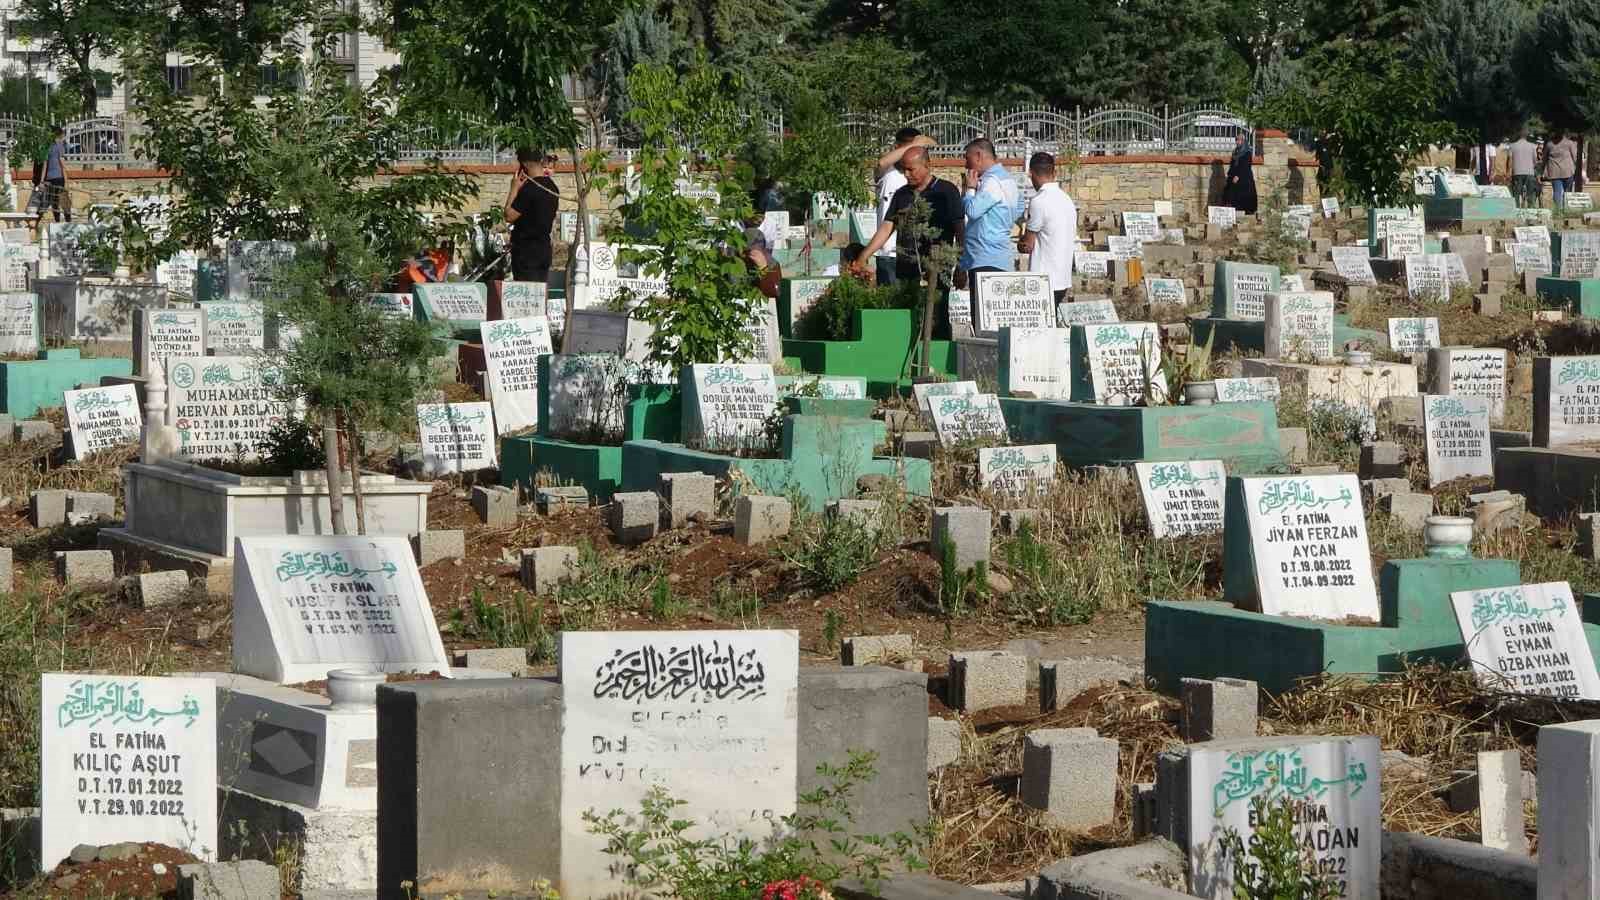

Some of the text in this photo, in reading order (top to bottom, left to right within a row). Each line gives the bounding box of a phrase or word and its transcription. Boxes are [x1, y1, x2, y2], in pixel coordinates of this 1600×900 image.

[630, 280, 664, 290] TURHAN
[1238, 282, 1270, 292] ABDULLAH
[992, 299, 1040, 310] ELİF NARİN
[169, 326, 193, 334] FATİHA
[186, 389, 270, 402] MUHAMMED
[732, 385, 756, 394] FATİHA
[1576, 384, 1585, 394] EL
[703, 394, 731, 404] DORUK
[1559, 395, 1591, 406] FATMA
[98, 409, 119, 420] FATİHA
[177, 403, 281, 417] MERVAN ARSLAN
[77, 418, 122, 432] MUHAMMED
[1440, 420, 1471, 428] EL FATİHA
[428, 434, 454, 444] BEBEK
[181, 445, 231, 455] RUHUNA
[1169, 488, 1206, 498] EL FATİHA
[1163, 497, 1219, 511] UMUT ERGİN
[1282, 511, 1331, 526] EL FATİHA
[1266, 525, 1358, 543] JİYAN FERZAN
[1293, 543, 1337, 558] AYCAN
[311, 580, 376, 594] EL FATİHA
[1504, 620, 1555, 637] EL FATİHA
[1506, 636, 1552, 654] EYMAN
[1498, 652, 1570, 672] ÖZBAYHAN
[90, 731, 167, 750] EL FATİHA
[73, 753, 181, 776] KILIÇ AŞUT
[78, 778, 184, 796] D.T.17.01.2022
[78, 799, 185, 816] V.T.29.10.2022
